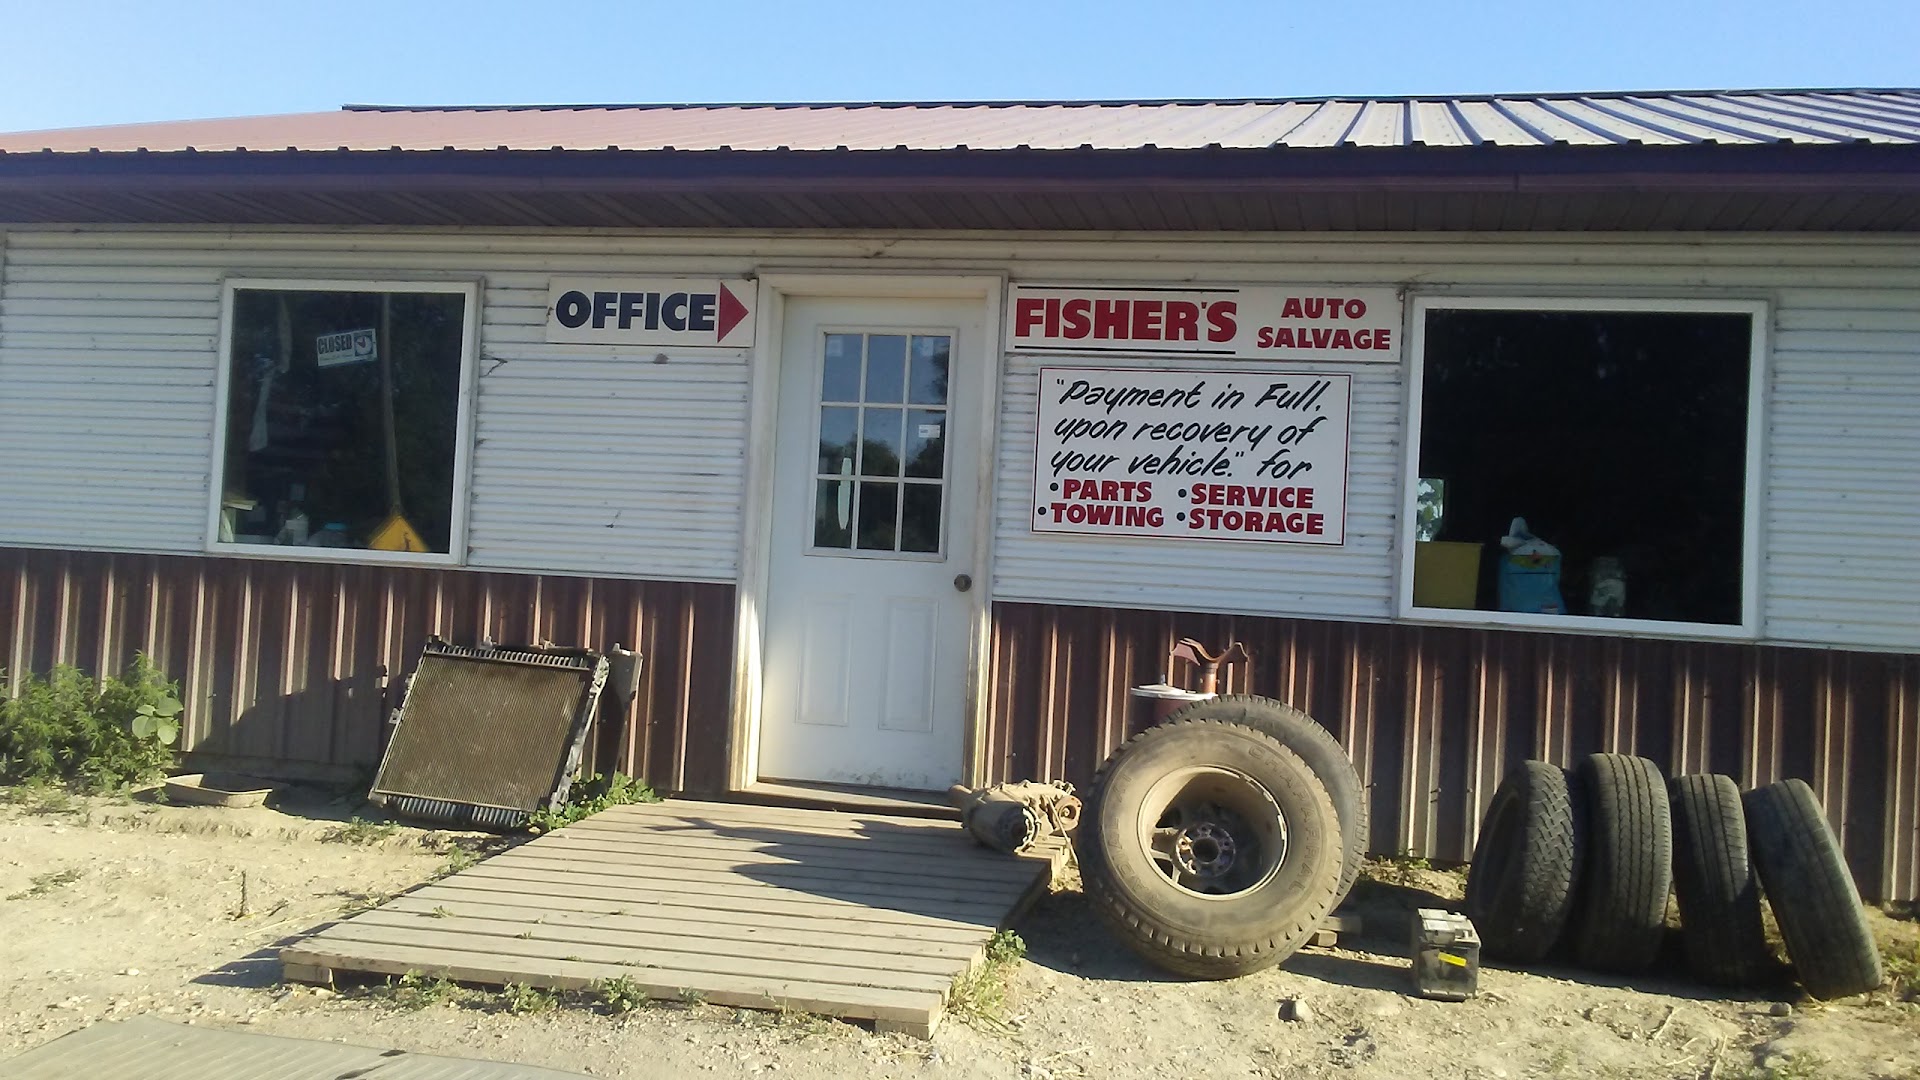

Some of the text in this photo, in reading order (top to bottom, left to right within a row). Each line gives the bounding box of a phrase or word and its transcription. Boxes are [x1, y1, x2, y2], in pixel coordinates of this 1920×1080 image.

[555, 290, 716, 331] OFFICE
[1015, 298, 1237, 343] FISHER'S
[1281, 298, 1366, 320] AUTO
[317, 334, 352, 354] CLOSED
[1257, 326, 1391, 350] SALVAGE
[1211, 384, 1245, 408] in
[1053, 415, 1328, 451] upon recovery of
[1050, 447, 1119, 477] your
[1256, 449, 1312, 480] for
[1062, 478, 1314, 509] PARTS SERVICE
[1050, 503, 1324, 535] TOWING STORAGE
